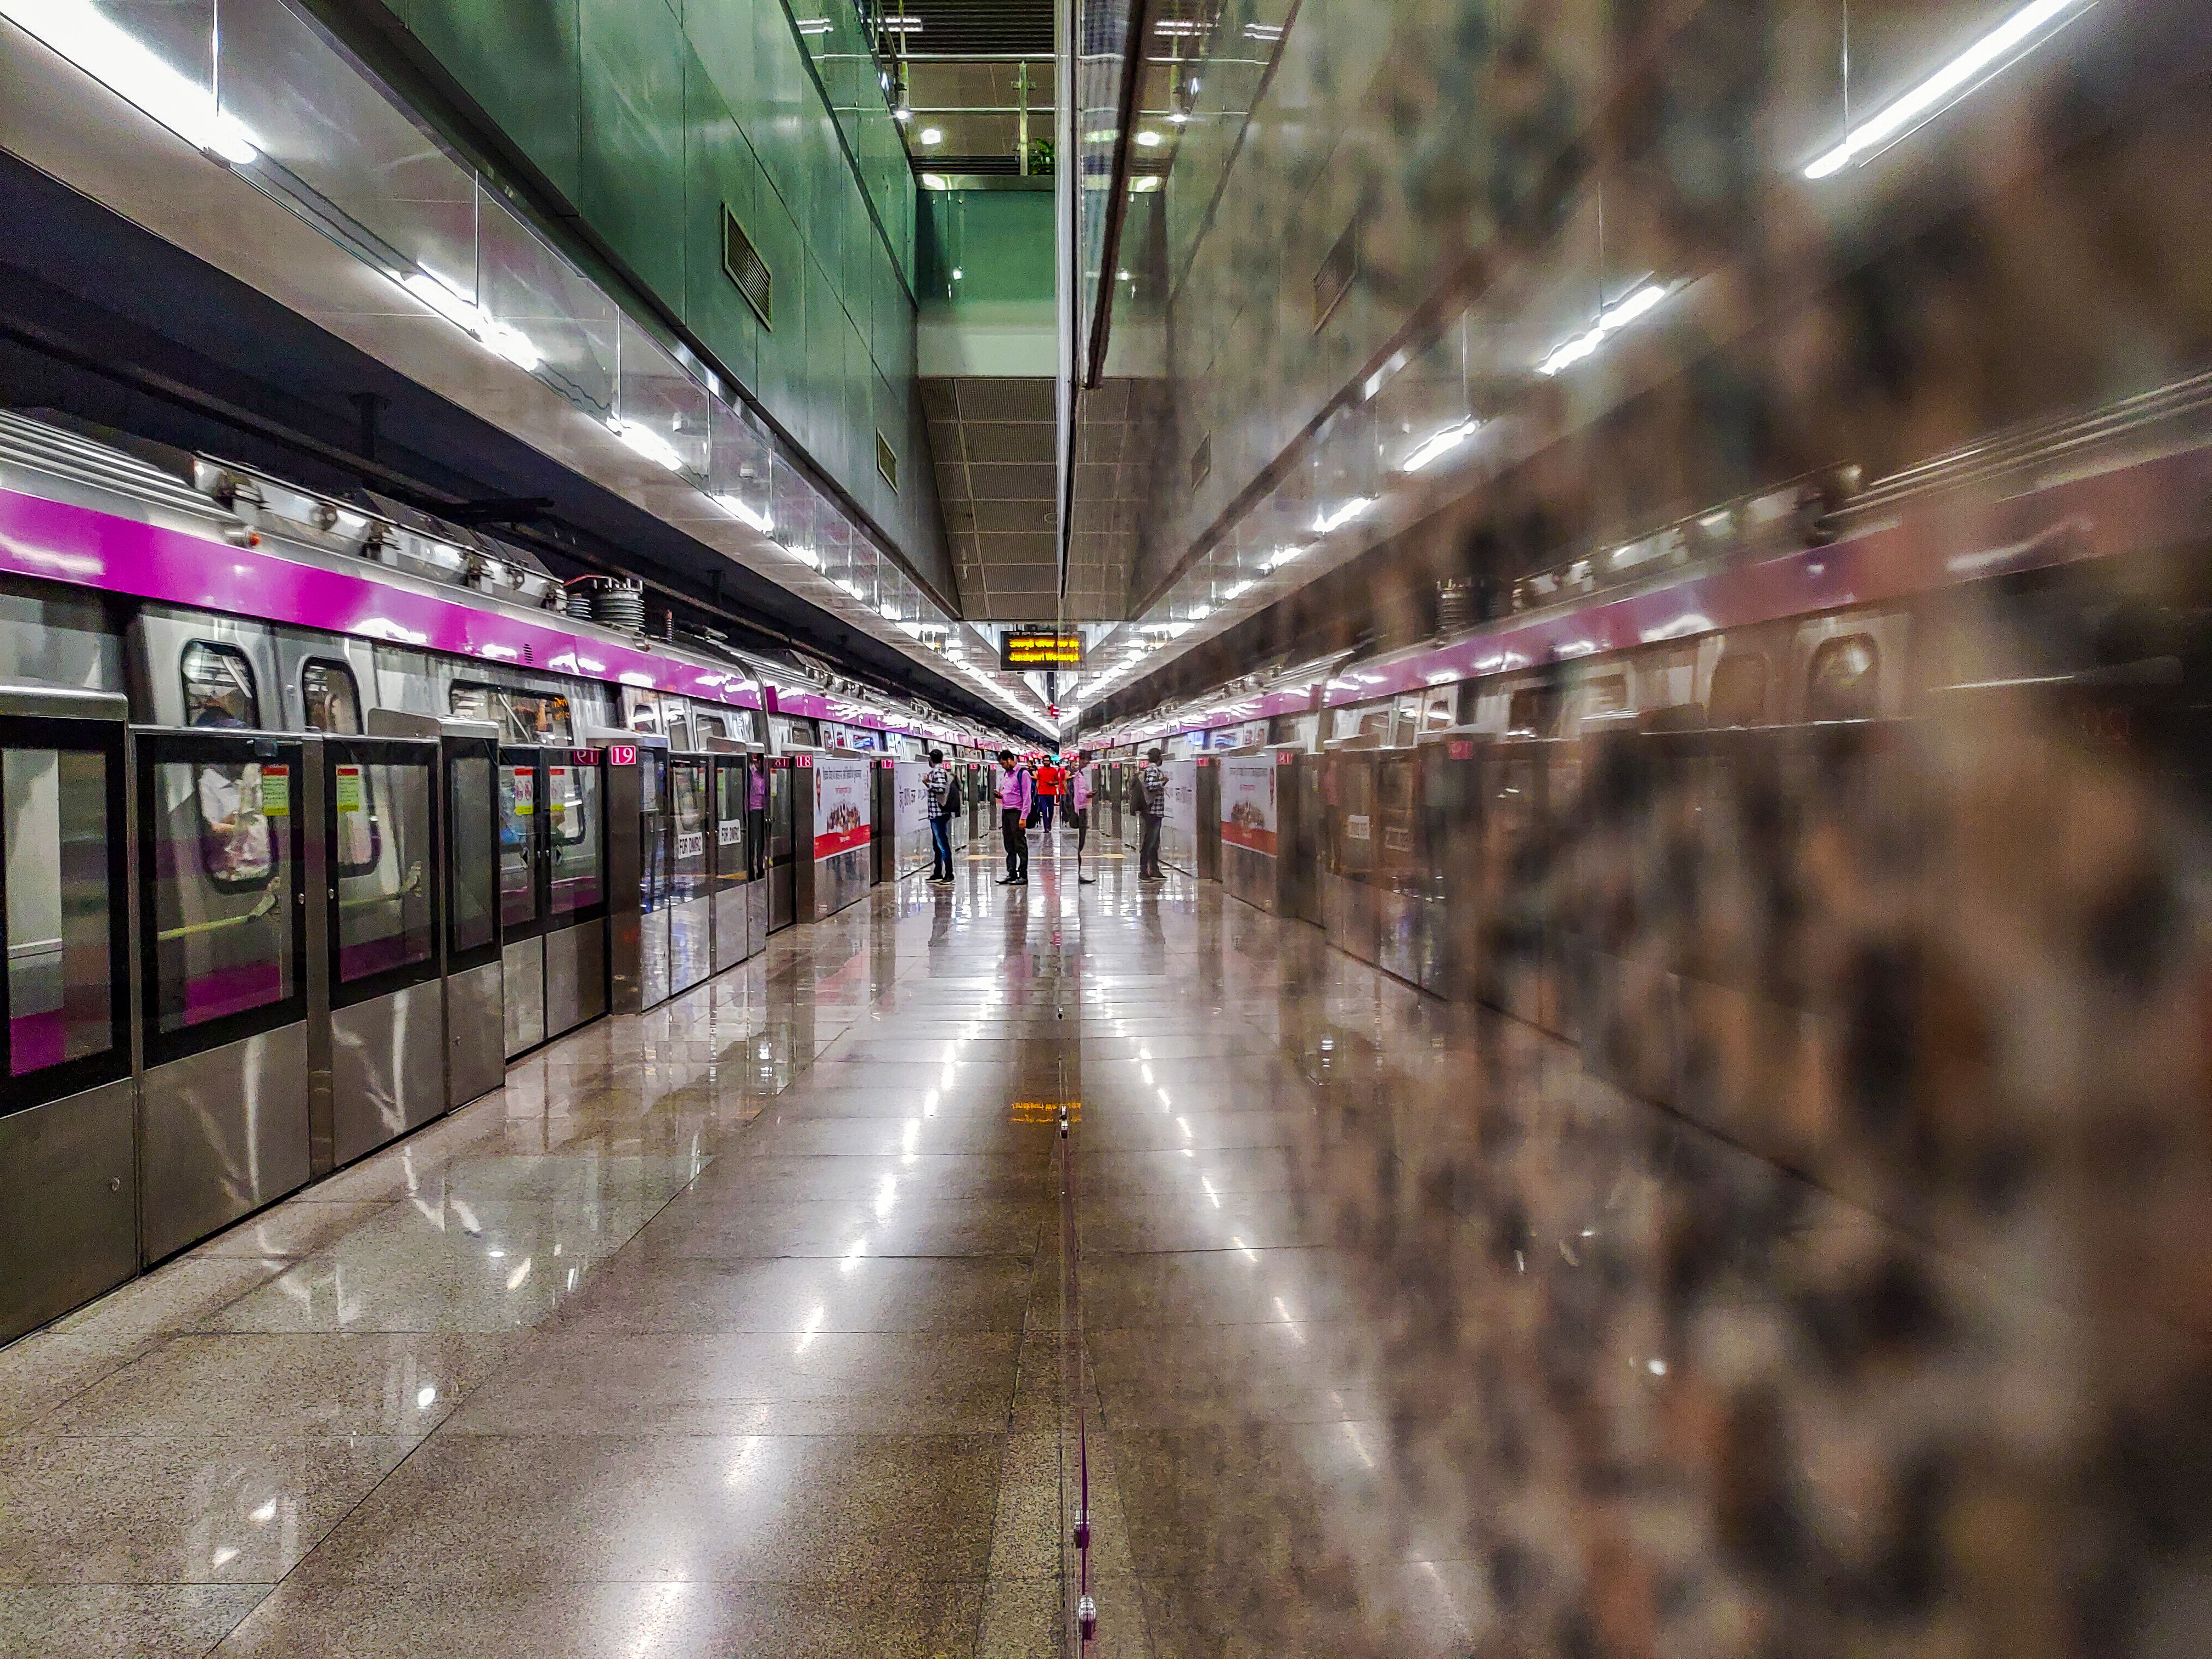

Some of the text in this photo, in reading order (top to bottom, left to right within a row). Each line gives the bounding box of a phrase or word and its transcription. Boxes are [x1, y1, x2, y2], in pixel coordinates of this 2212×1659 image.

[614, 747, 633, 764] 19
[799, 756, 811, 767] 18
[884, 759, 893, 768] 17
